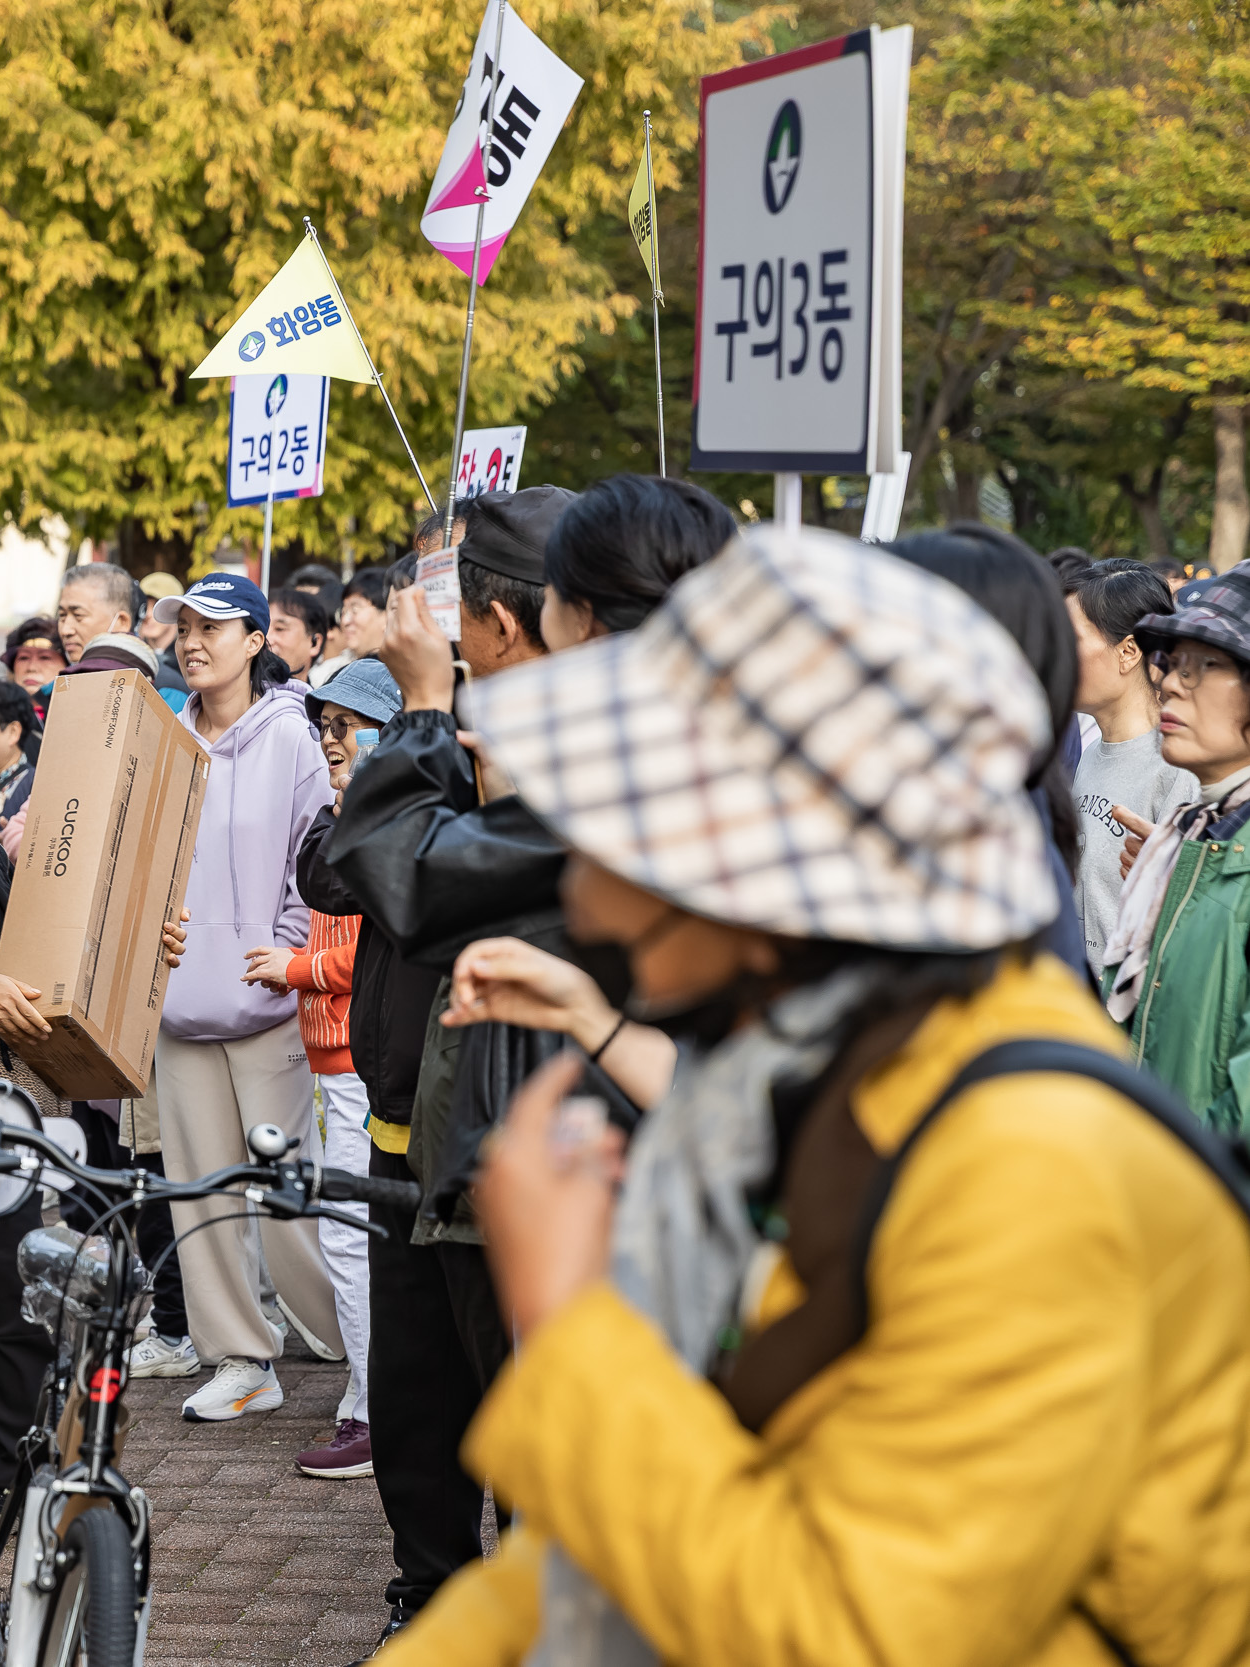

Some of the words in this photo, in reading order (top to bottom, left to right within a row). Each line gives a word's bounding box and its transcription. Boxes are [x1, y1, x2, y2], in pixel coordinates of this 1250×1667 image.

[267, 293, 342, 349] 화양동
[715, 249, 852, 383] 구의3동
[239, 425, 309, 482] 구의2동
[54, 798, 79, 876] CUCKOO
